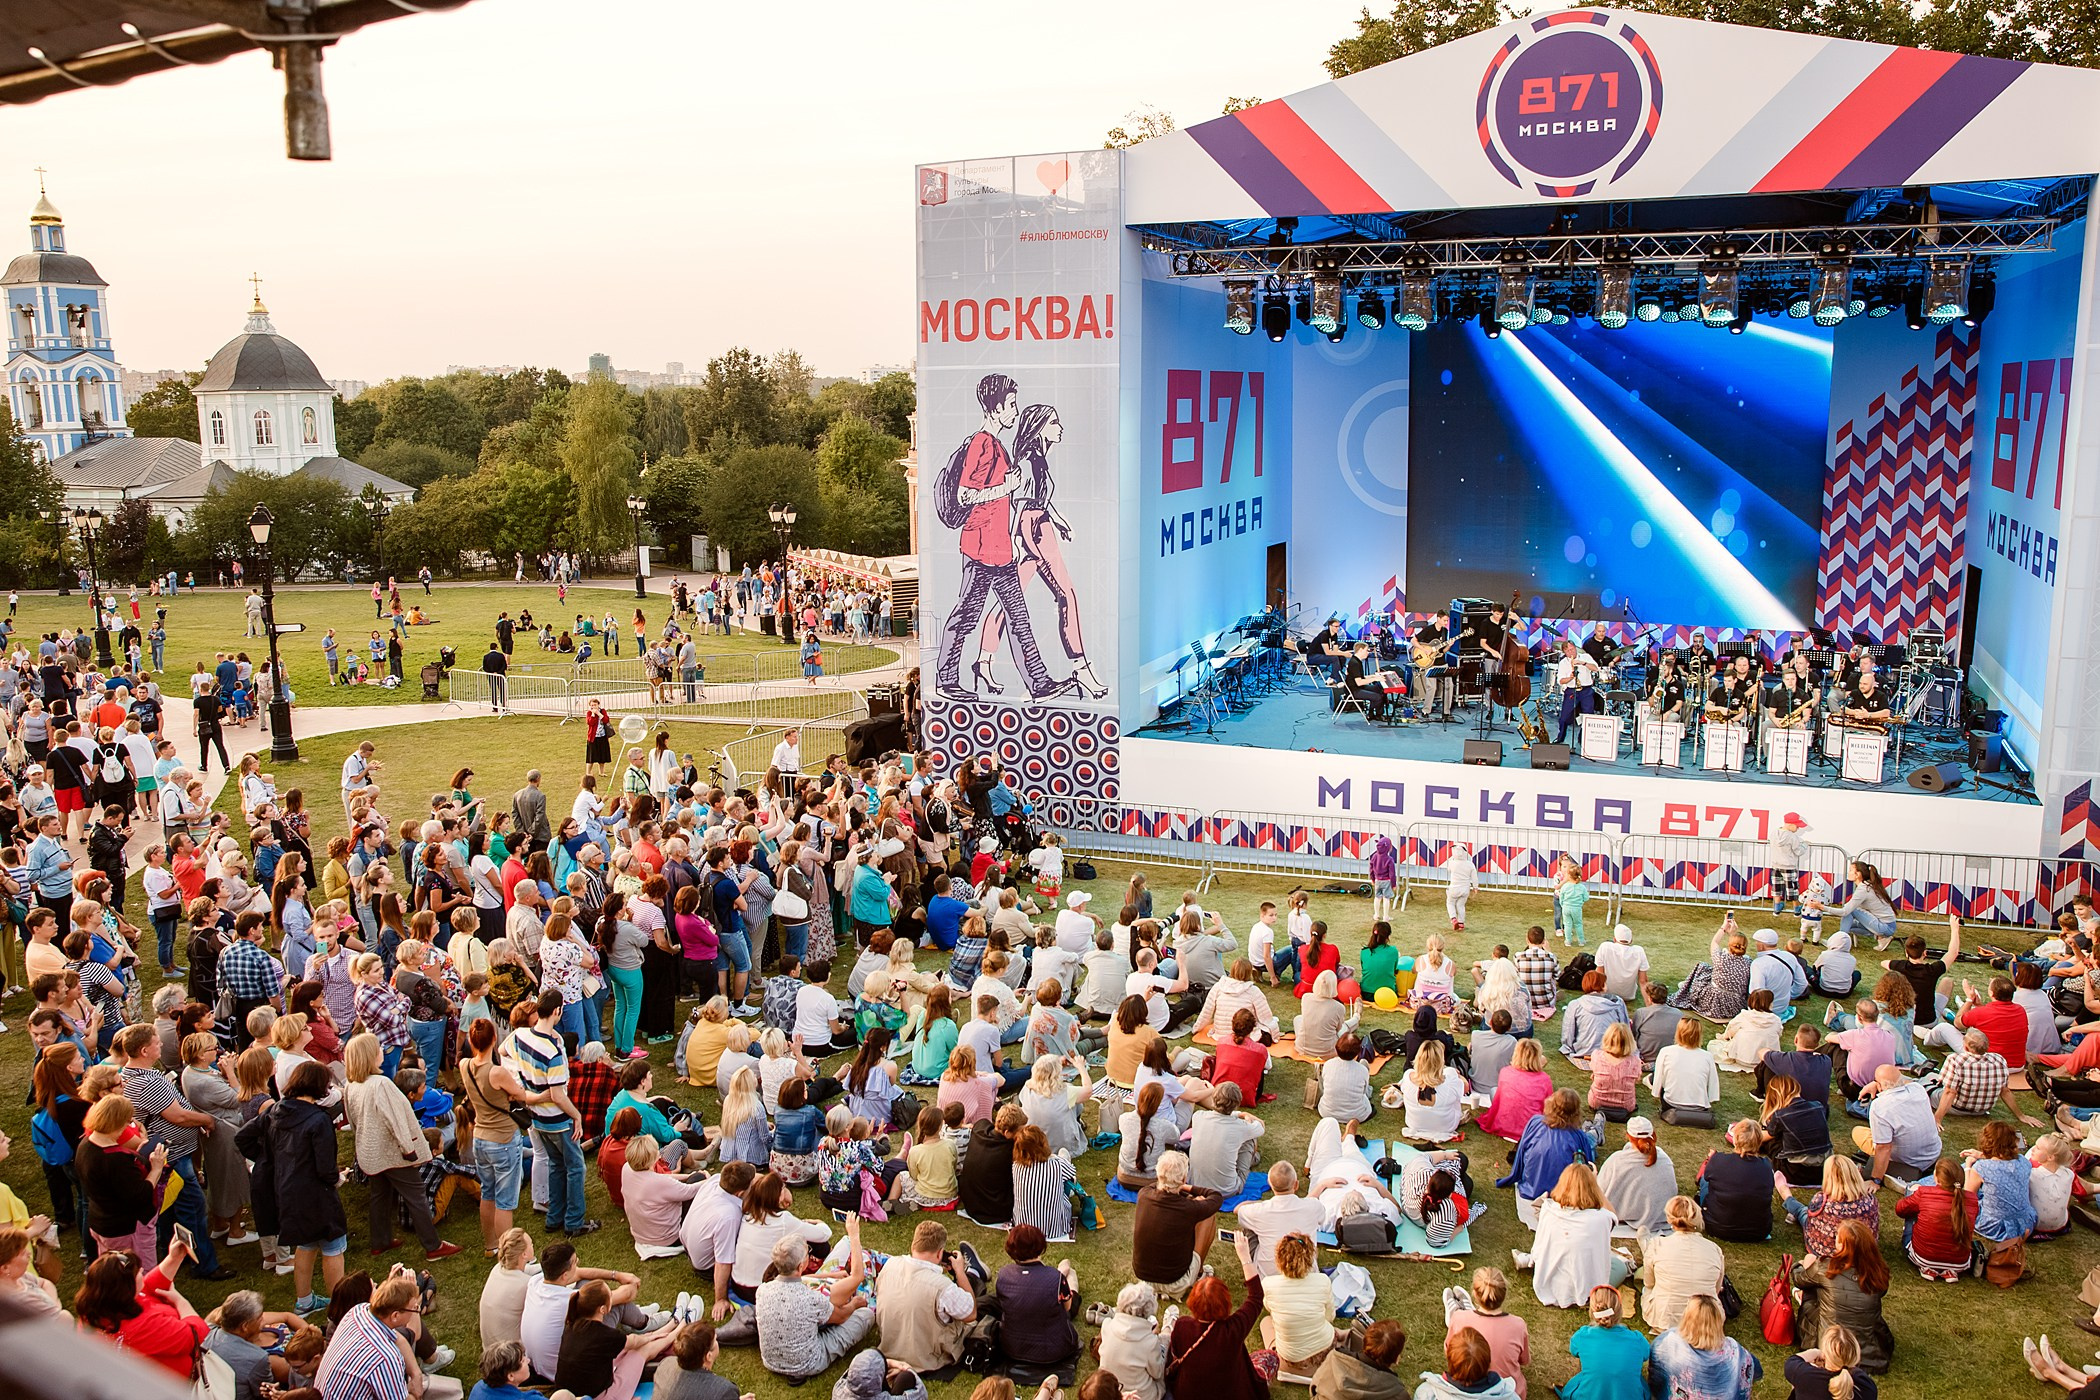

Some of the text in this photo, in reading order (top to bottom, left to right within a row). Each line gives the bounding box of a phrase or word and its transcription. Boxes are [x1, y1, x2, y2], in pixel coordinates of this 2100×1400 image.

[1518, 71, 1619, 115] 871
[1518, 118, 1617, 137] МОСКВА
[1020, 229, 1109, 242] #ялюблюмоскву
[921, 294, 1114, 343] МОСКВА!
[1161, 369, 1265, 495] 871
[1992, 358, 2073, 511] 871
[1161, 496, 1263, 557] МОСКВА
[1987, 509, 2058, 587] МОСКВА
[1318, 775, 1769, 841] МОСКВА 871
